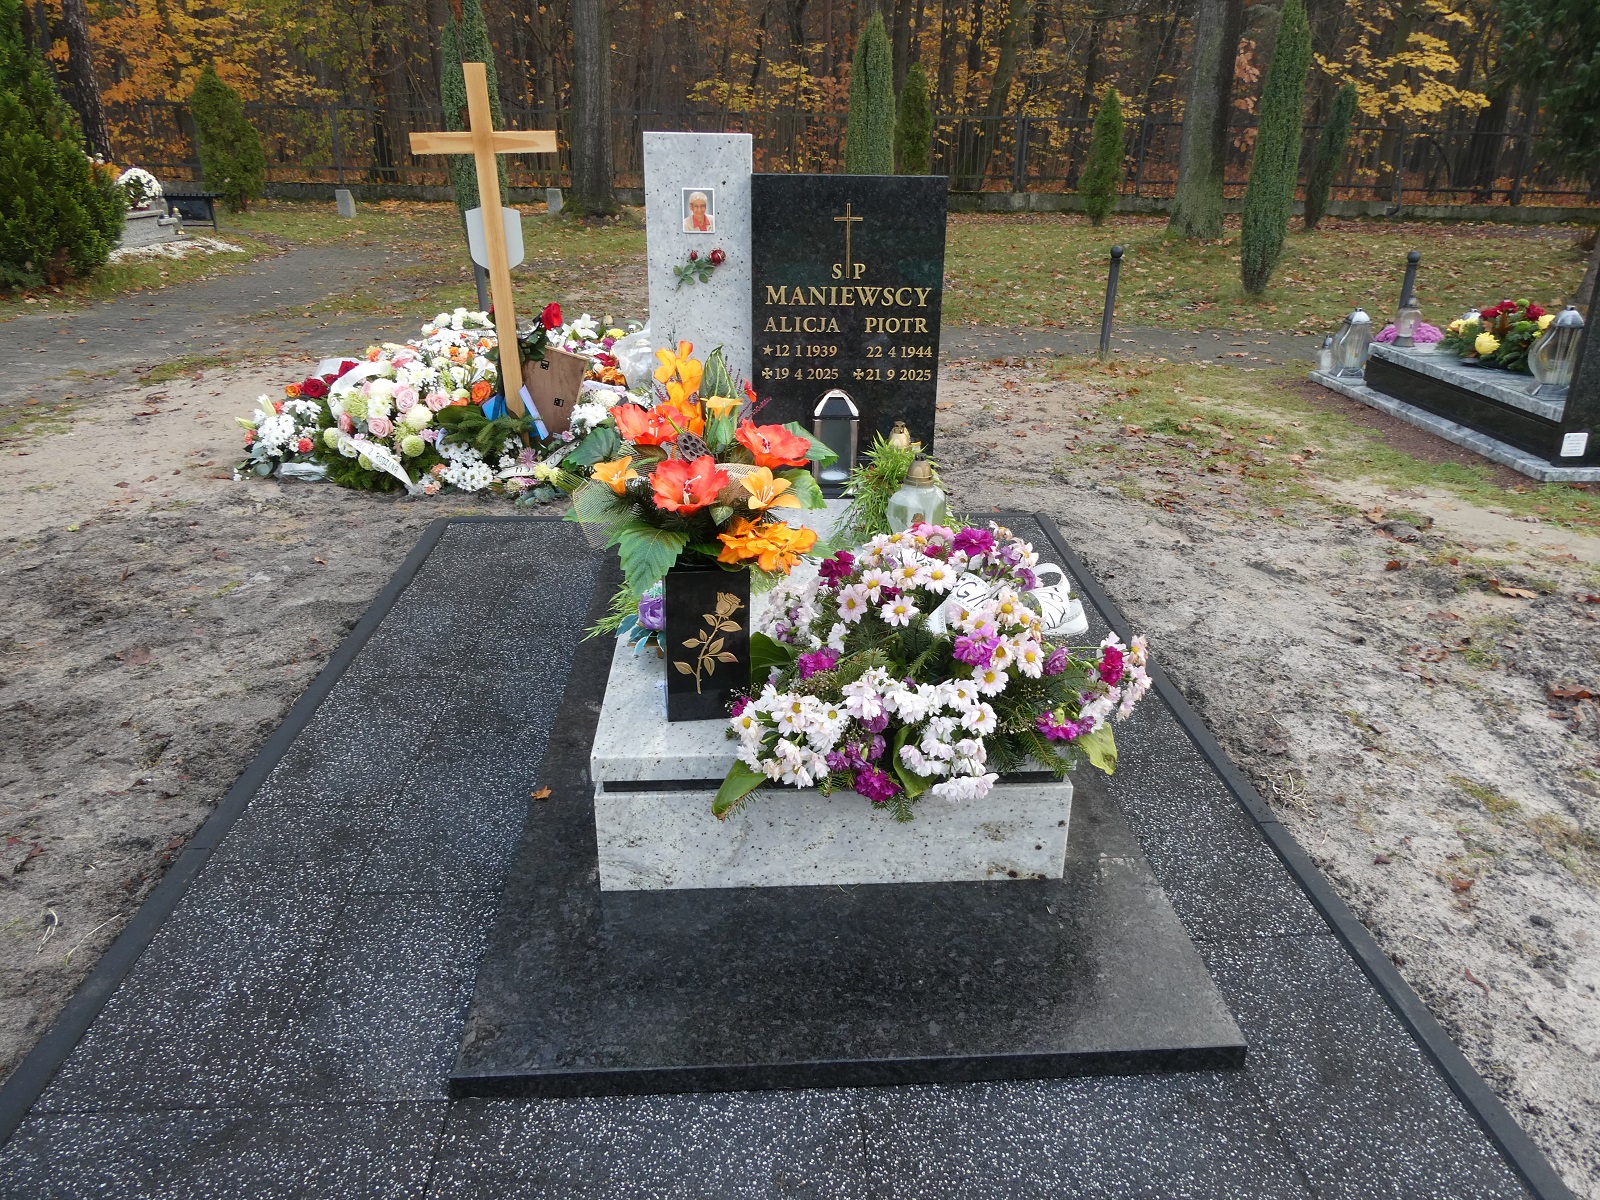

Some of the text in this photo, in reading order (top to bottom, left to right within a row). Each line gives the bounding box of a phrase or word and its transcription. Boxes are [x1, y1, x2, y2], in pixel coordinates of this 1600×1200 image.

[831, 263, 866, 280] S P
[765, 285, 932, 307] MANIEWSCY
[763, 316, 840, 333] ALICJA
[864, 317, 928, 334] PIOTR
[775, 344, 790, 357] 12
[806, 344, 838, 358] 1939
[866, 345, 932, 358] 22 4 1944
[775, 367, 839, 380] 19 4 2025
[865, 368, 932, 381] 21 9 2025
